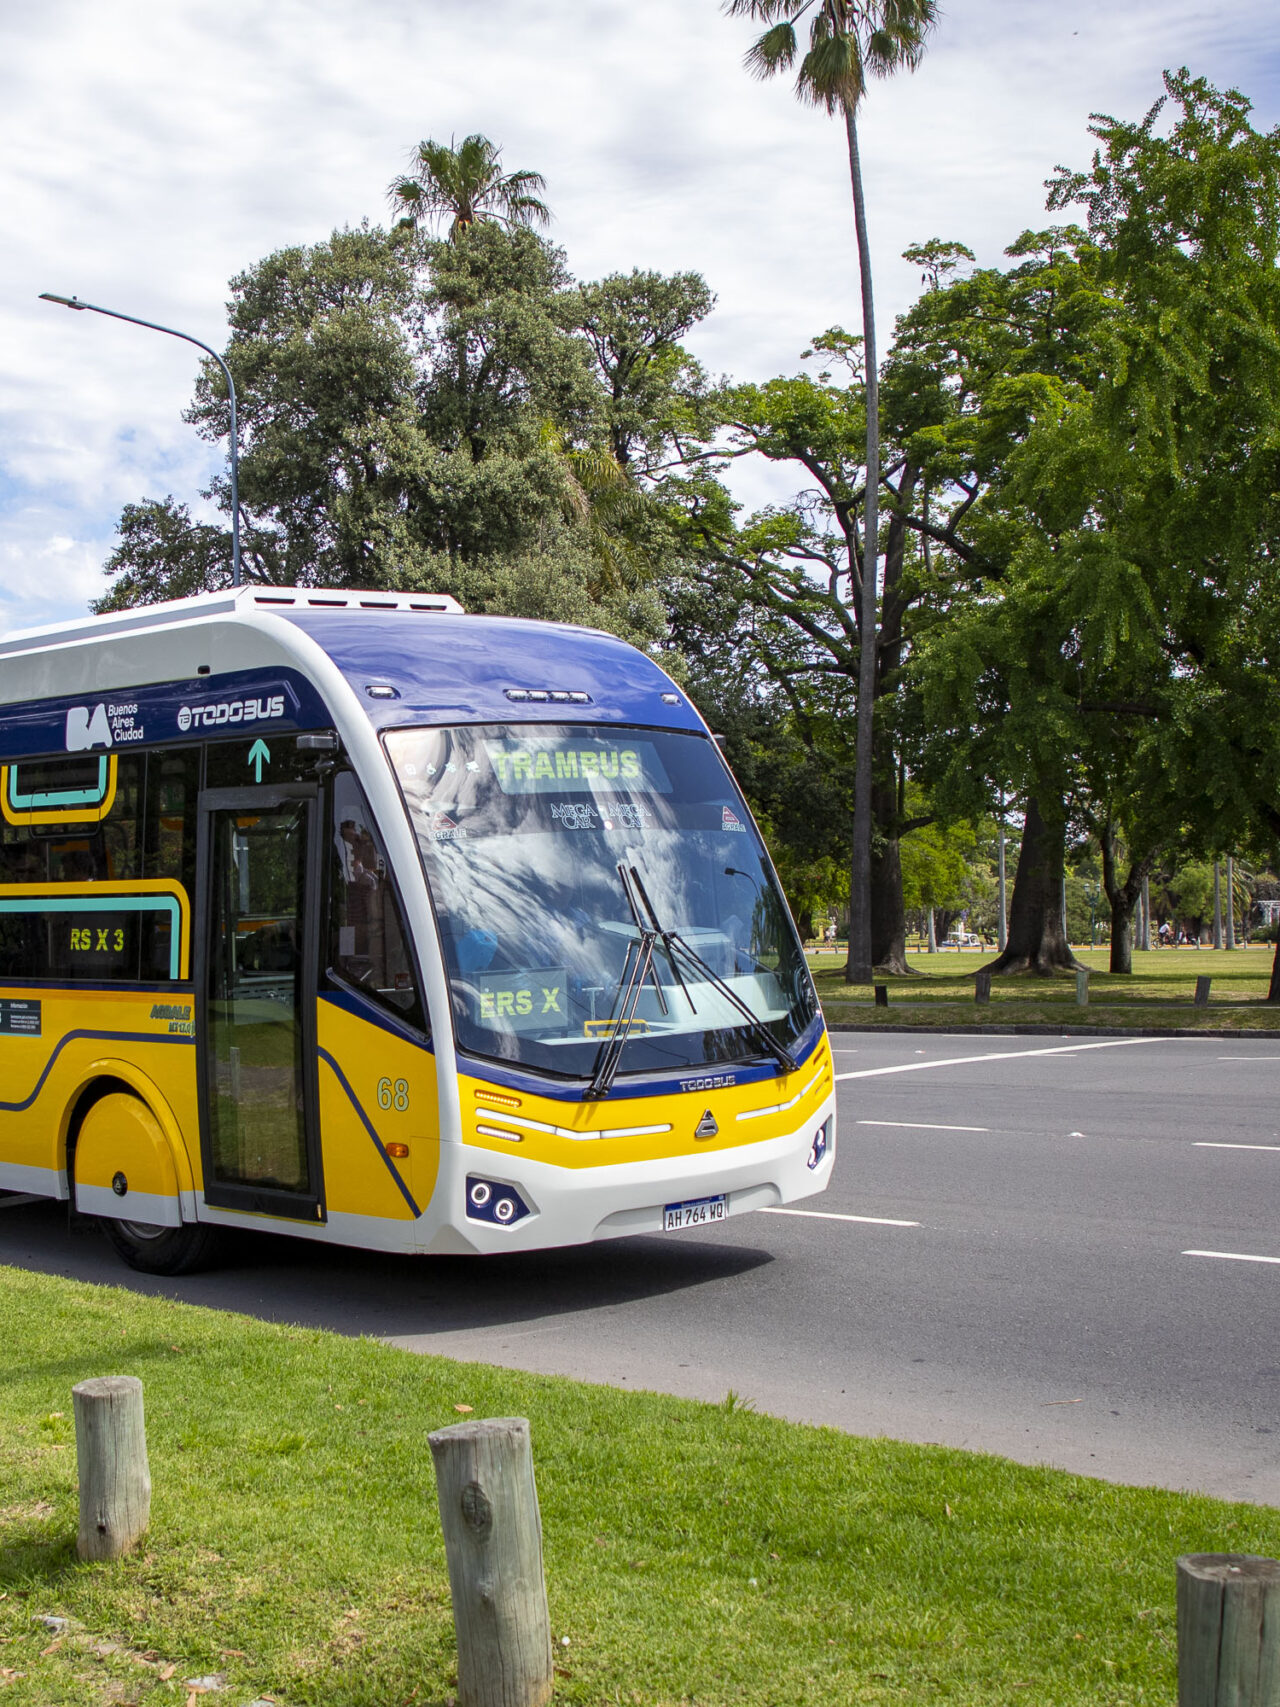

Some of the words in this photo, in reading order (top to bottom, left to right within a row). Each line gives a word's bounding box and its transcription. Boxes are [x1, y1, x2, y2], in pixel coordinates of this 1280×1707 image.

[108, 704, 138, 716] Buenos
[192, 695, 285, 727] TODOBUS
[112, 717, 135, 729] Aires
[114, 726, 144, 742] Ciudad
[495, 750, 640, 780] TRAMBUS
[550, 801, 598, 818] MEGA
[608, 802, 652, 817] MEGA
[561, 815, 596, 830] CAR
[70, 928, 91, 951] RS
[95, 928, 110, 952] X
[113, 928, 124, 952] 3
[480, 989, 533, 1019] ERS
[541, 986, 561, 1014] X
[680, 1074, 736, 1092] TODOBUS
[377, 1076, 409, 1112] 68
[667, 1210, 682, 1229] AH
[685, 1206, 706, 1225] 764
